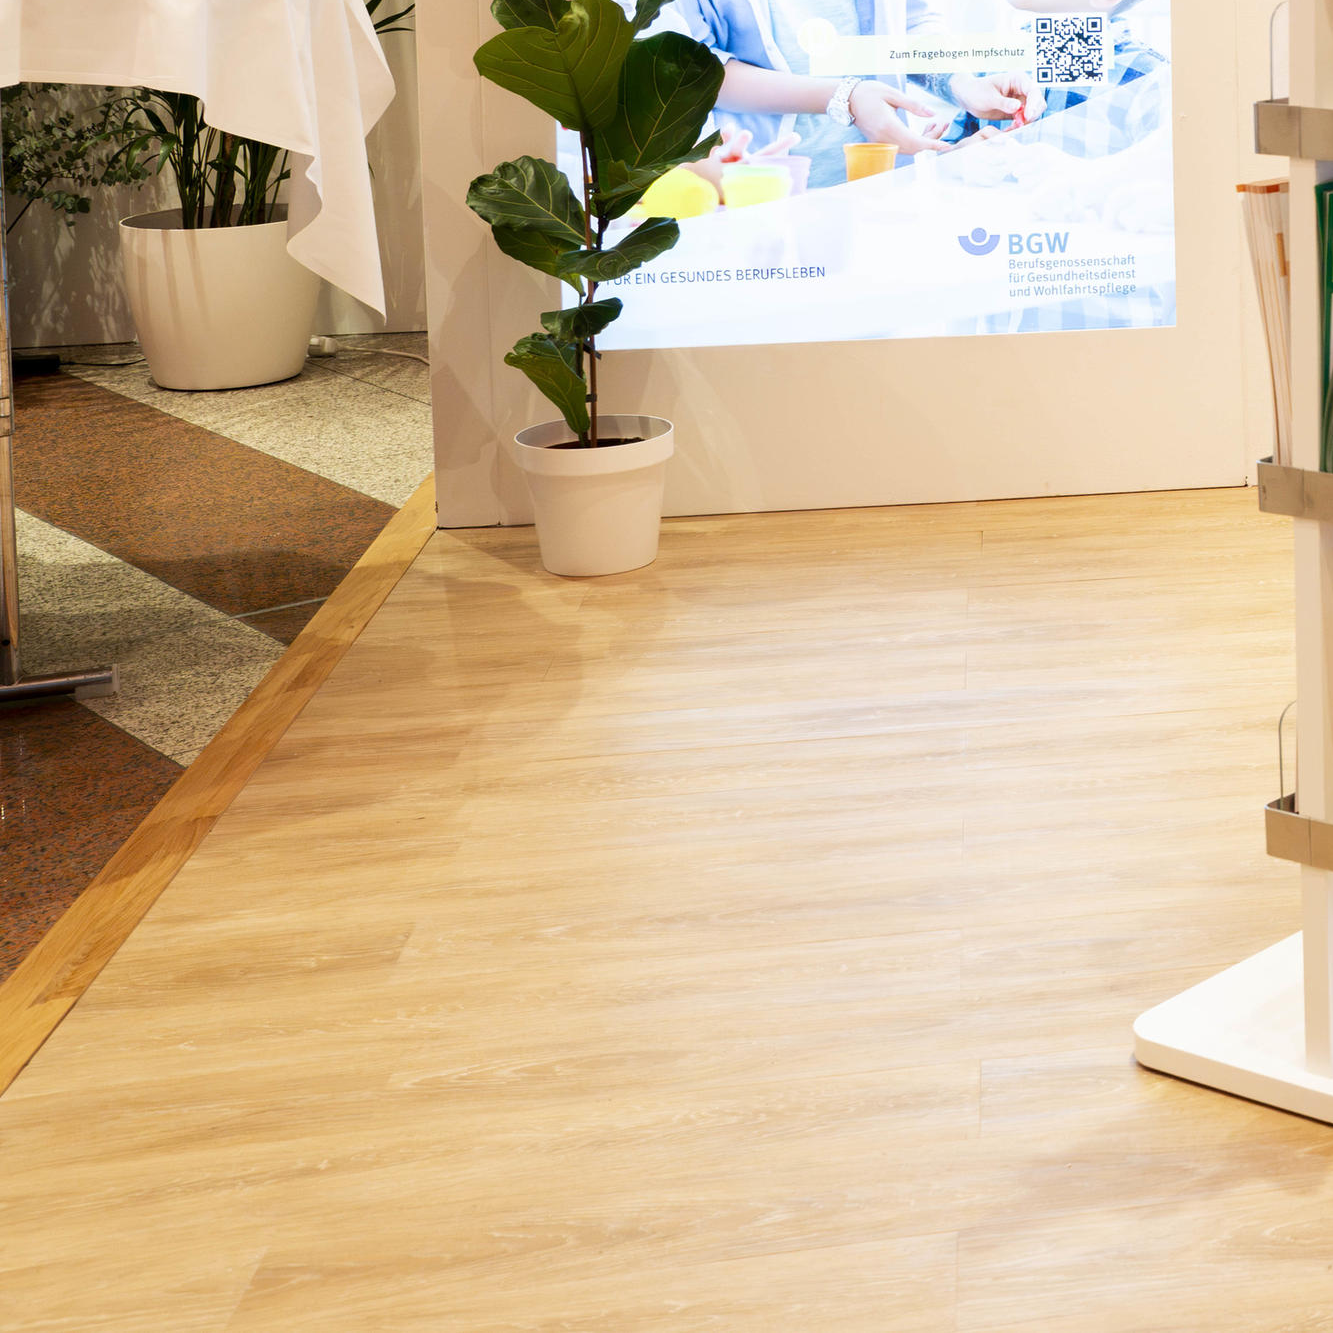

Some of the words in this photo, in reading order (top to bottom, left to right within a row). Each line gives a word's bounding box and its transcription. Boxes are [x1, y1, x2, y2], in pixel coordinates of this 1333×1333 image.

[889, 49, 909, 59] Zum
[912, 48, 969, 61] Fragebogen
[971, 46, 1025, 60] Impfschutz
[1008, 232, 1069, 255] BGW
[1008, 254, 1136, 270] Berufsgenossenschaft
[635, 272, 656, 285] EIN
[660, 270, 731, 283] GESUNDES
[736, 266, 825, 281] BERUFSLEBEN
[1008, 272, 1025, 284] für
[1027, 268, 1136, 284] Gesundheitsdienst
[1008, 285, 1031, 298] und
[1033, 282, 1136, 299] Wohlfahrtspflege
